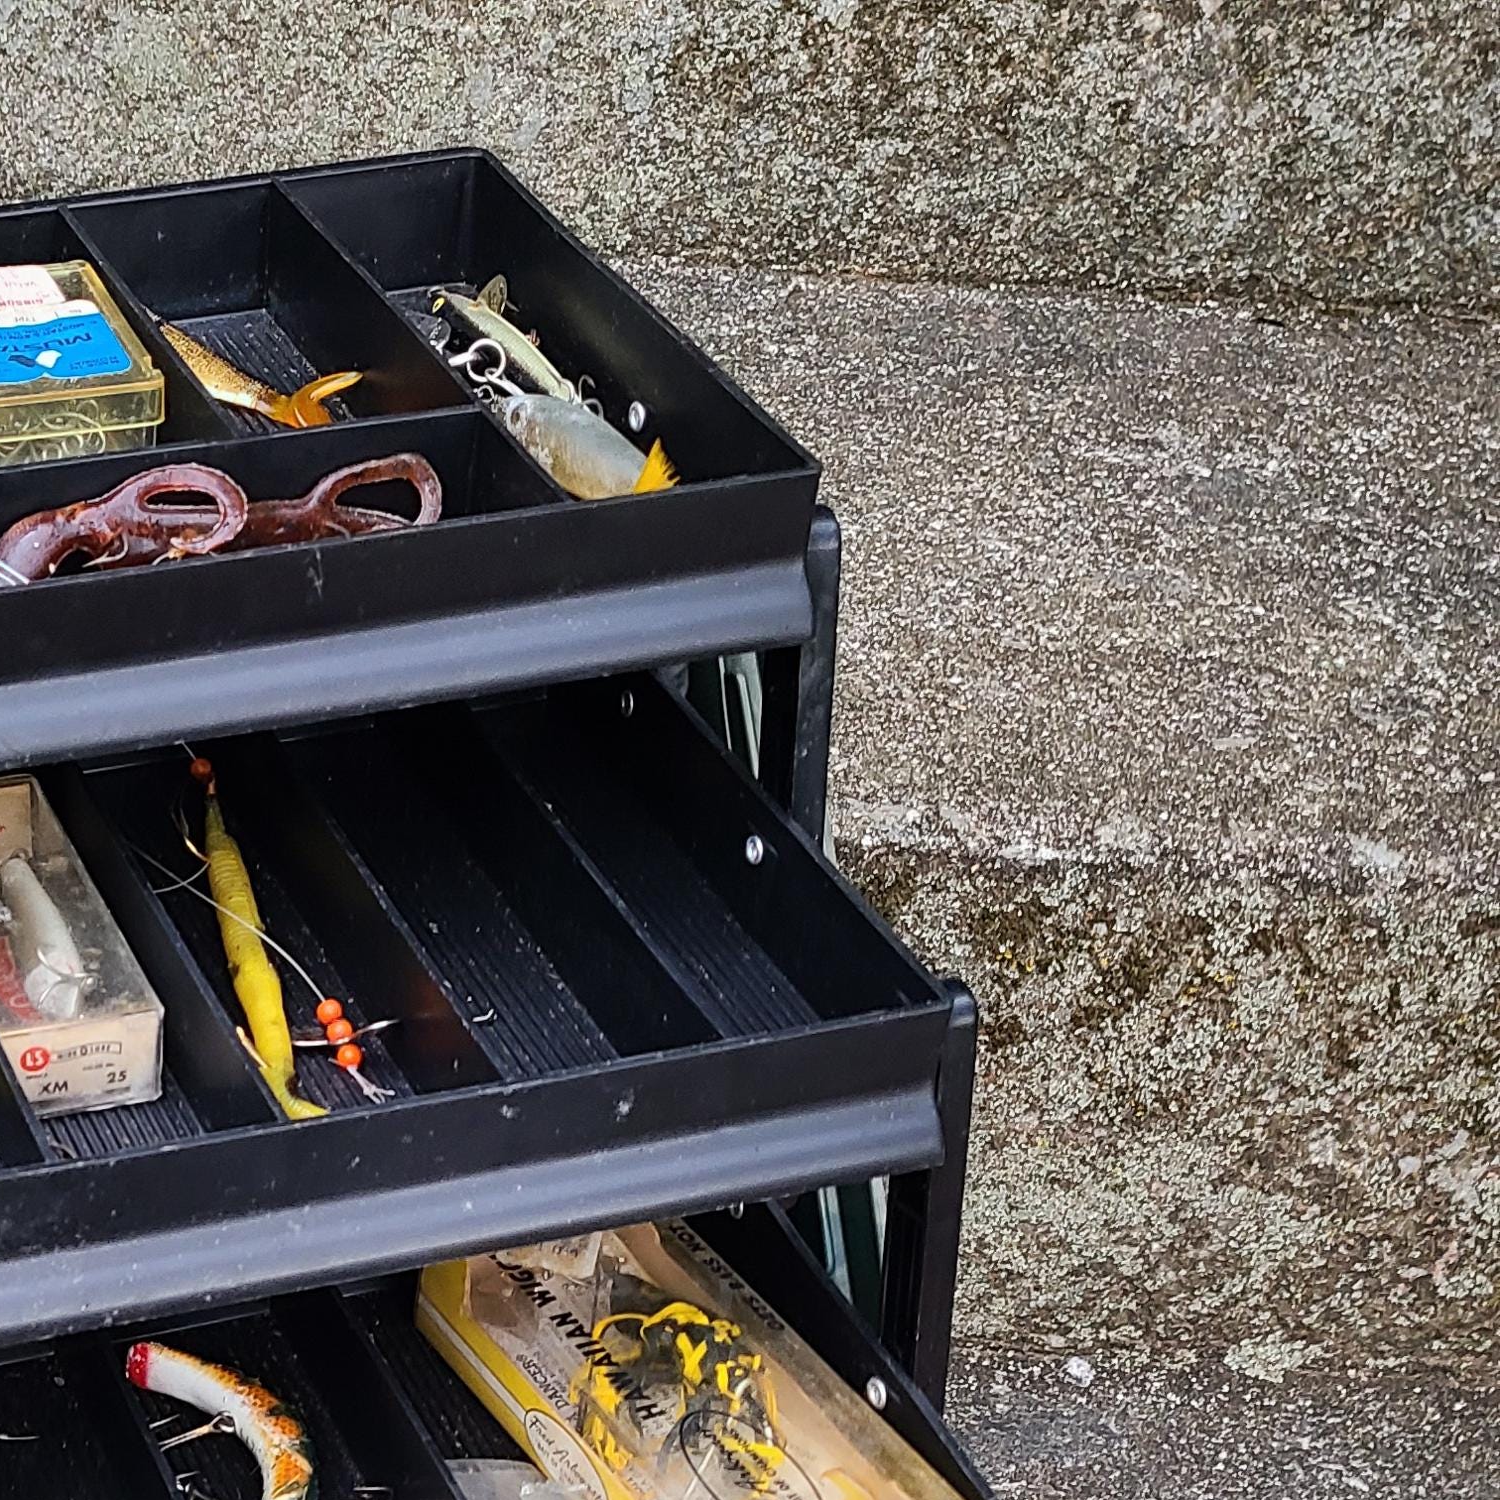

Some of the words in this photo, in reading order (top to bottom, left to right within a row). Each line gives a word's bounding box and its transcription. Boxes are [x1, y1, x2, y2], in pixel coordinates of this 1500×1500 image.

[107, 1071, 126, 1083] 25
[39, 1080, 68, 1094] XM
[551, 1311, 666, 1420] HAWAIIAN
